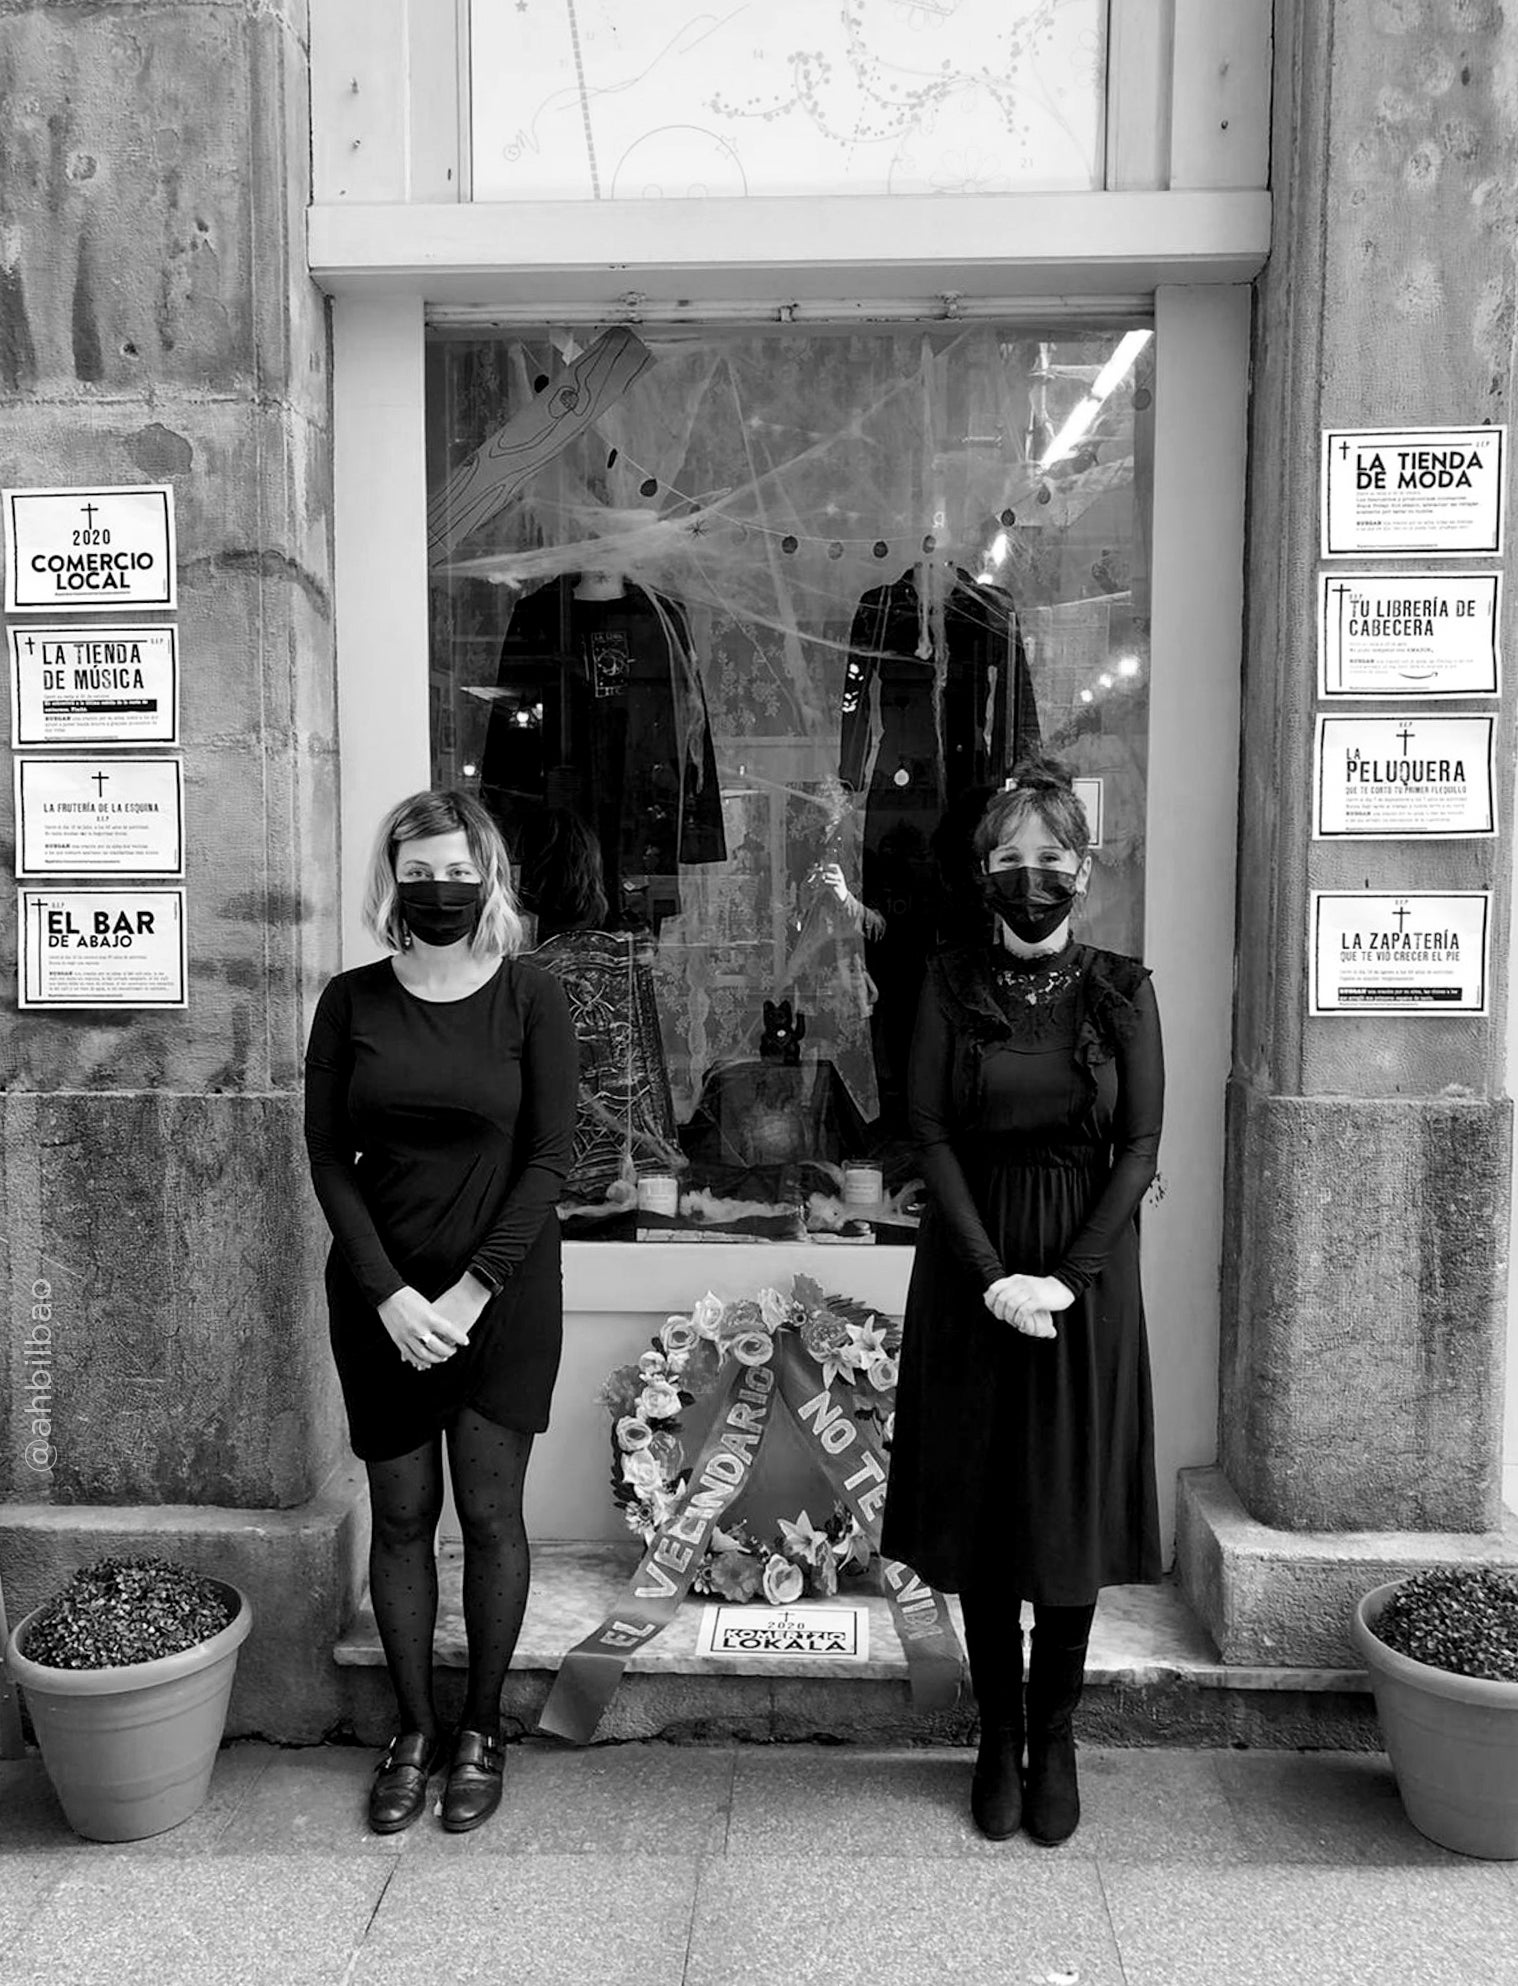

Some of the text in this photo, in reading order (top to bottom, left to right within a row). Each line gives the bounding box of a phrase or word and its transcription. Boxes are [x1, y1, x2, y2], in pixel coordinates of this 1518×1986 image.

[1356, 451, 1483, 471] LA TIENDA
[1356, 470, 1472, 489] DE MODA
[73, 529, 111, 546] 2020
[31, 552, 154, 573] COMERCIO
[56, 572, 131, 590] LOCAL
[1349, 600, 1370, 617] TU
[1376, 596, 1448, 617] LIBRERÍA
[1456, 600, 1476, 617] DE
[1349, 619, 1434, 636] CABECERA
[42, 643, 141, 665] LA TIENDA
[43, 664, 144, 690] DE MÚSICA
[1346, 748, 1361, 760] LA
[1346, 760, 1466, 786] PELUQUERA
[1345, 786, 1357, 795] QUE
[1360, 786, 1368, 794] TE
[43, 801, 159, 814] LA FRUTERÍA DE LA ESQUINA
[48, 910, 155, 935] EL BAR
[48, 935, 133, 948] DE ABAJO
[1342, 929, 1460, 950] LA ZAPATERÍA
[1340, 951, 1357, 963] QUE
[1361, 951, 1372, 961] TE
[1393, 951, 1429, 961] CRECER
[1432, 951, 1441, 961] EL
[1446, 951, 1460, 961] PIE
[797, 1389, 857, 1454] NO
[844, 1450, 887, 1522] TE
[600, 1366, 774, 1647] EL VECINDARIO
[768, 1622, 805, 1630] 2020
[723, 1638, 846, 1651] LOKALA
